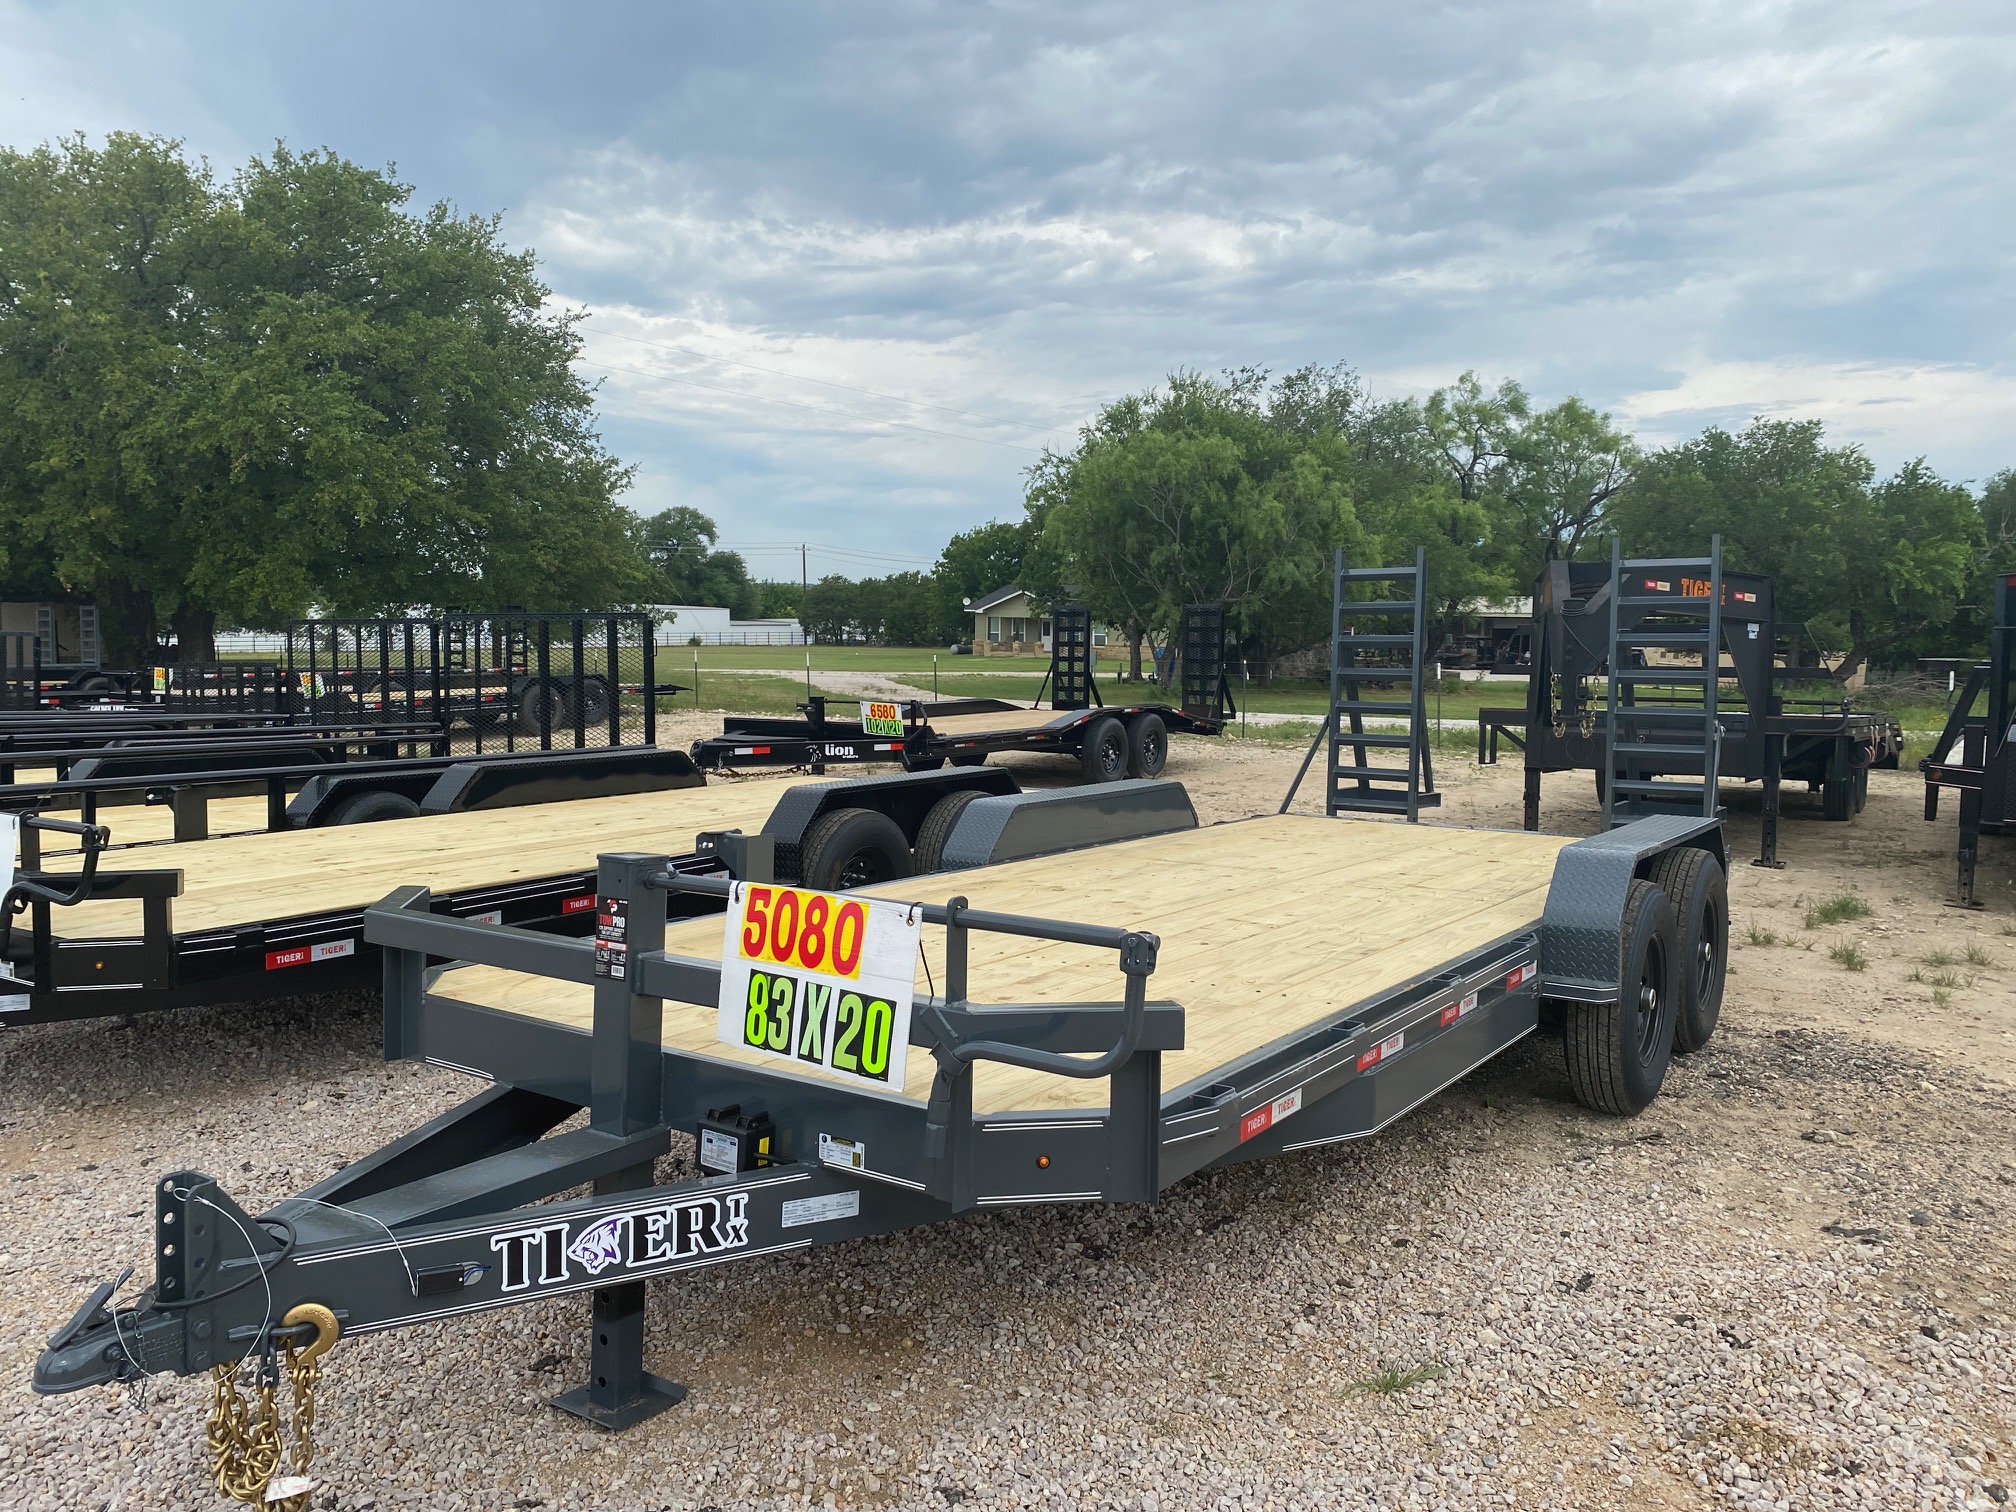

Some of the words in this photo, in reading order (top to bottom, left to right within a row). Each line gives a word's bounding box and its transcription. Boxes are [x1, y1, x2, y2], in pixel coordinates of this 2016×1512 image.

[1681, 578, 1711, 597] TIGE
[870, 703, 896, 720] 6580
[825, 743, 854, 756] lion
[570, 899, 589, 909] TIGER
[743, 887, 864, 976] 5080
[276, 952, 303, 964] TIGER
[1279, 1097, 1295, 1114] TIGER
[1247, 1113, 1266, 1133] TIGER
